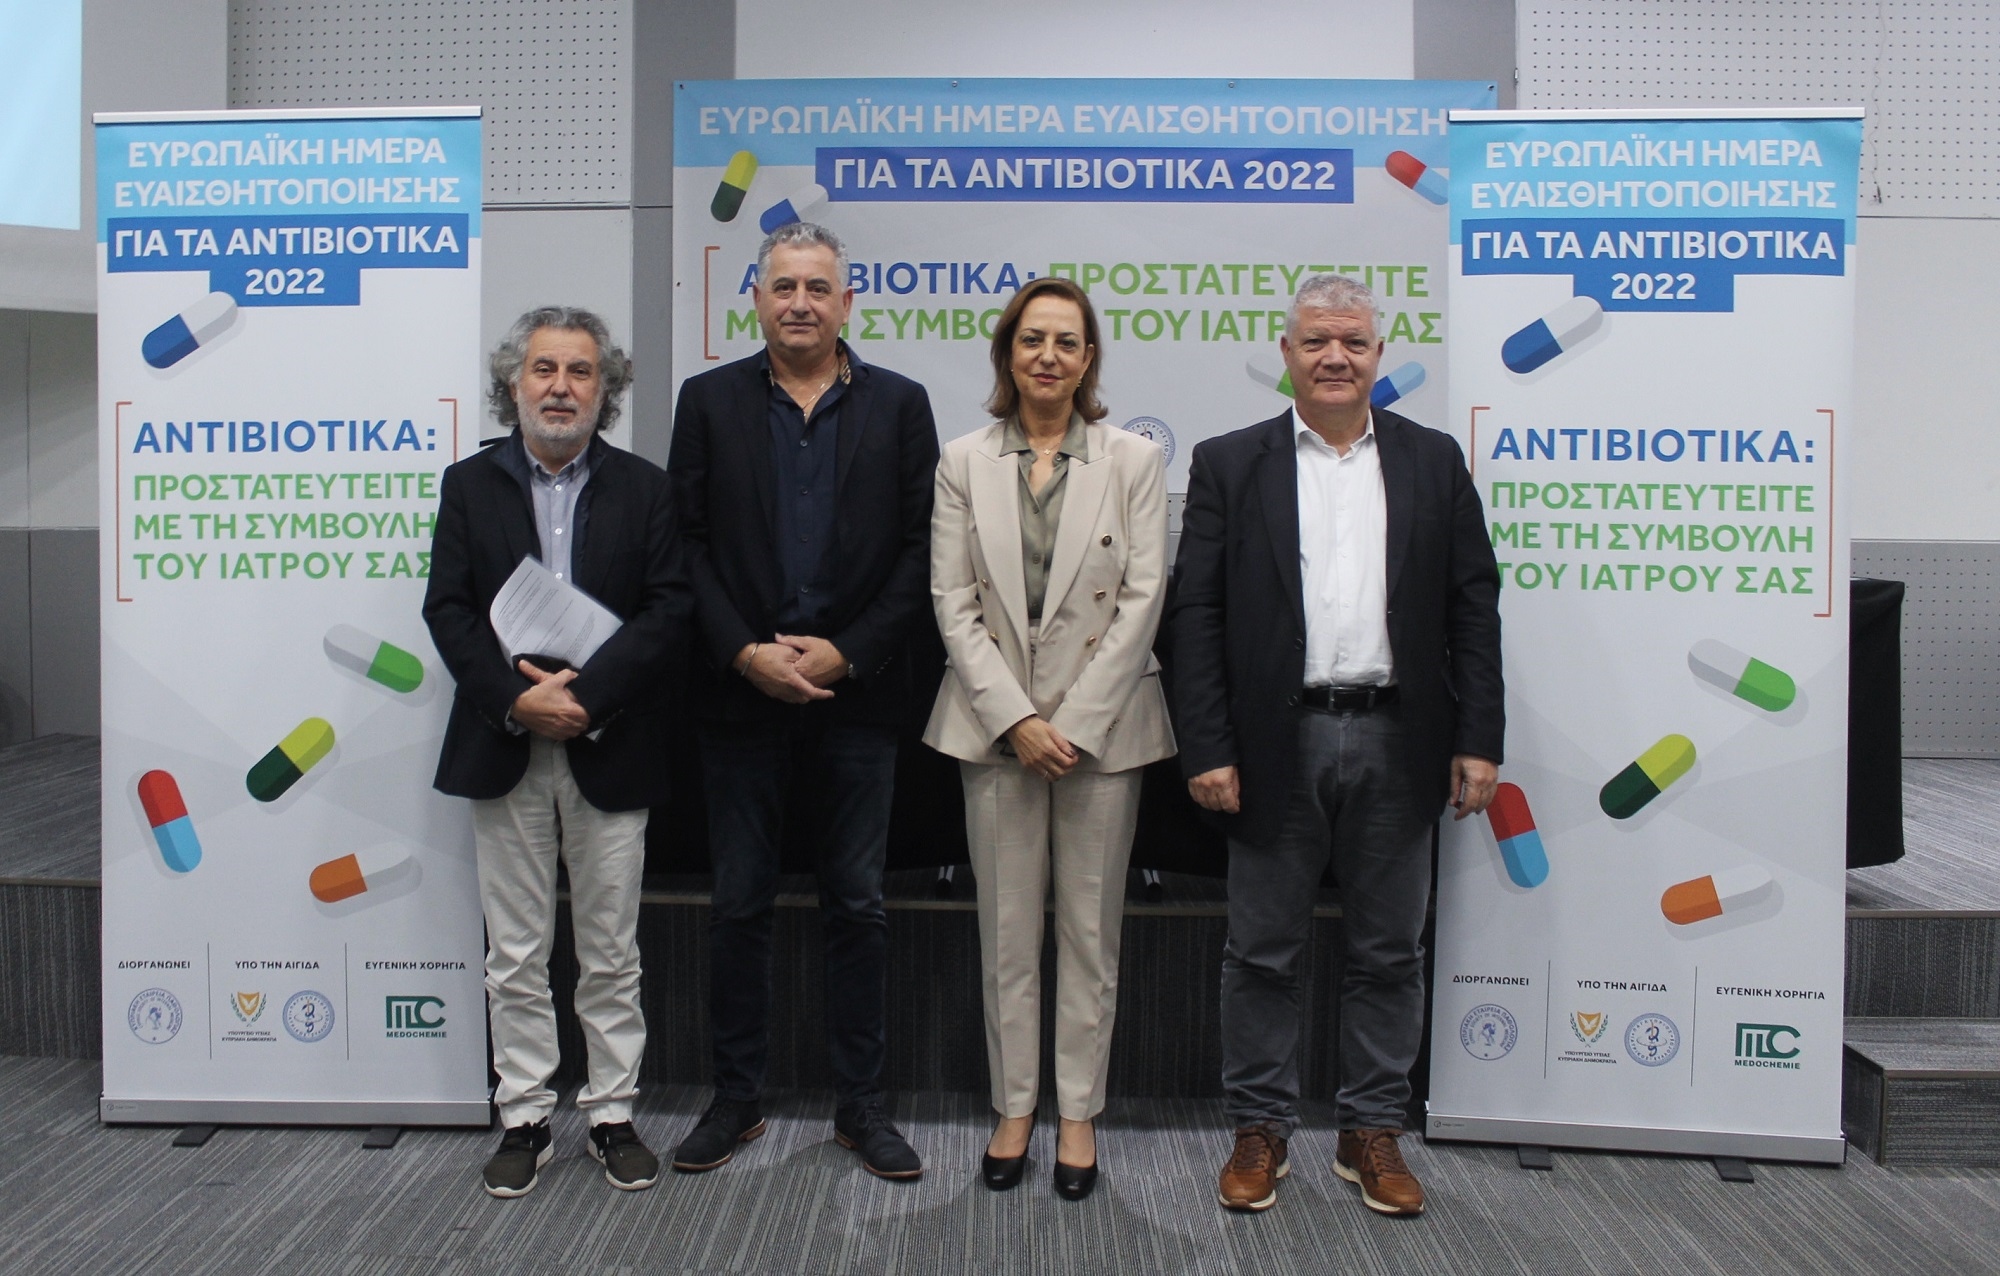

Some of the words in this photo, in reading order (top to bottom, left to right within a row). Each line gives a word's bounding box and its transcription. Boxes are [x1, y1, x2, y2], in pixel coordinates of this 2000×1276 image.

[700, 98, 923, 135] ΕΥΡΩΠΑΪΚΗ
[934, 105, 1064, 134] ΗΜΕΡΑ
[1075, 105, 1446, 136] ΕΥΑΙΣΘΗΤΟΠΟΙΗΣΗ
[128, 133, 324, 168] ΕΥΡΩΠΑΪΚΗ
[331, 138, 446, 164] ΗΜΕΡΑ
[1486, 133, 1693, 168] ΕΥΡΩΠΑΪΚΗ
[1702, 139, 1822, 167] ΗΜΕΡΑ
[834, 158, 897, 189] ΓΙΑ
[905, 158, 957, 189] ΤΑ
[964, 158, 1235, 190] ΑΝΤΙΒΙΟΤΙΚΑ
[1243, 160, 1335, 191] 2022
[115, 177, 460, 208] ΕΥΑΙΣΘΗΤΟΠΟΙΗΣΗΣ
[1471, 181, 1837, 209] ΕΥΑΙΣΘΗΤΟΠΟΙΗΣΗΣ
[115, 229, 169, 258] ΓΙΑ
[175, 229, 220, 256] ΤΑ
[225, 226, 460, 255] ΑΝΤΙΒΙΟΤΙΚΑ
[1471, 232, 1529, 260] ΓΙΑ
[1537, 231, 1583, 259] ΤΑ
[1590, 230, 1837, 261] ΑΝΤΙΒΙΟΤΙΚΑ
[245, 268, 325, 295] 2022
[738, 262, 1036, 295] ΑΒΙΟΤΙΚΑ:
[1611, 272, 1696, 300] 2022
[725, 309, 767, 340] Μ
[860, 308, 1005, 340] ΣΥΜΒΟ
[1104, 309, 1191, 342] ΤΟΥ
[1201, 310, 1287, 343] ΙΑΤΡ
[1379, 312, 1443, 344] ΑΣ
[133, 420, 436, 453] ΑΝΤΙΒΙΟΤΙΚΑ:
[1491, 428, 1814, 464] ΑΝΤΙΒΙΟΤΙΚΑ:
[134, 472, 437, 501] ΠΡΟΣΤΑΤΕΥΤΕΙΤΕ
[1491, 481, 1814, 513] ΠΡΟΣΤΑΤΕΥΤΕΙΤΕ
[134, 514, 181, 540] ΜΕ
[189, 513, 236, 539] ΤΗ
[245, 512, 437, 539] ΣΥΜΒΟΥΛΗ
[1491, 522, 1541, 549] ΜΕ
[1550, 523, 1598, 550] ΤΗ
[1608, 523, 1814, 553] ΣΥΜΒΟΥΛΗ
[134, 553, 208, 580] ΤΟΥ
[220, 552, 354, 580] ΙΑΤΡΟΥ
[365, 552, 431, 579] ΣΑΣ
[1497, 562, 1568, 590] ΤΟΥ
[1581, 563, 1723, 593] ΙΑΤΡΟΥ
[1736, 566, 1813, 595] ΣΑΣ
[118, 960, 191, 969] ΔΙΟΡΓΑΝΩΝΕΙ
[235, 960, 258, 969] ΥΠΟ
[260, 961, 282, 969] ΤΗΝ
[285, 961, 320, 970] ΑΙΓΙΔΑ
[365, 961, 417, 970] ΕΥΓΕΝΙΚΗ
[420, 962, 466, 970] ΧΟΡΗΓΙΑ
[1453, 975, 1529, 986] ΔΙΟΡΓΑΝΩΝΕΙ
[1577, 980, 1600, 989] ΥΠΟ
[1604, 981, 1627, 990] ΤΗΝ
[1630, 983, 1667, 992] ΑΙΓΙΔΑ
[1716, 987, 1772, 997] ΕΥΓΕΝΙΚΗ
[1775, 990, 1825, 1000] ΧΟΡΗΓΙΑ
[1735, 1060, 1800, 1069] MEDOCHEMIE
